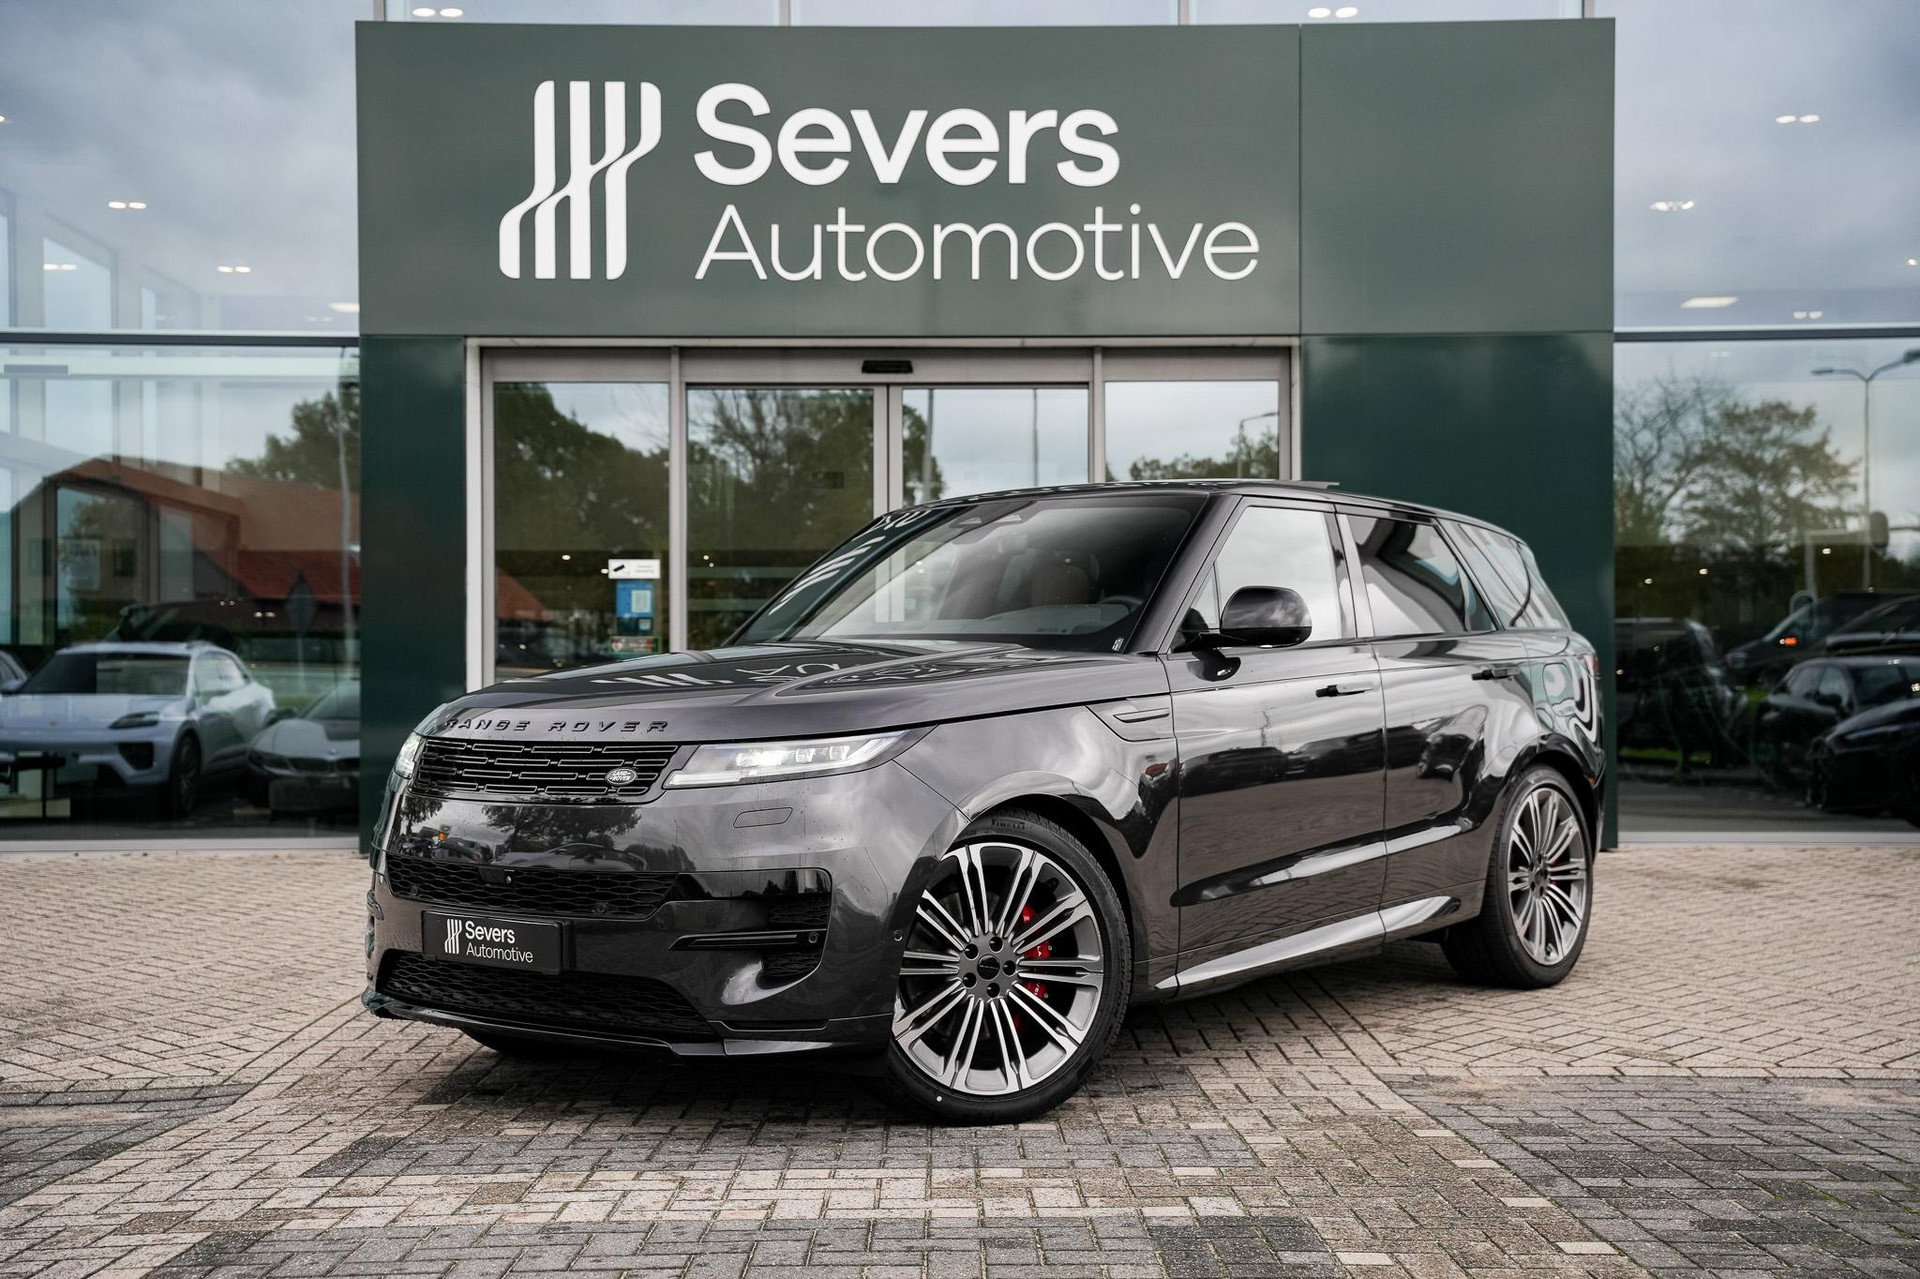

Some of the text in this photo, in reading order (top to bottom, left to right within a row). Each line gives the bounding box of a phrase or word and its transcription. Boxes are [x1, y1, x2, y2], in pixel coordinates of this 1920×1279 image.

[694, 83, 1121, 187] Severs
[694, 203, 1260, 282] Automotive
[443, 718, 668, 732] RANGE ROVER
[465, 920, 516, 944] Severs
[466, 942, 534, 963] Automotive
